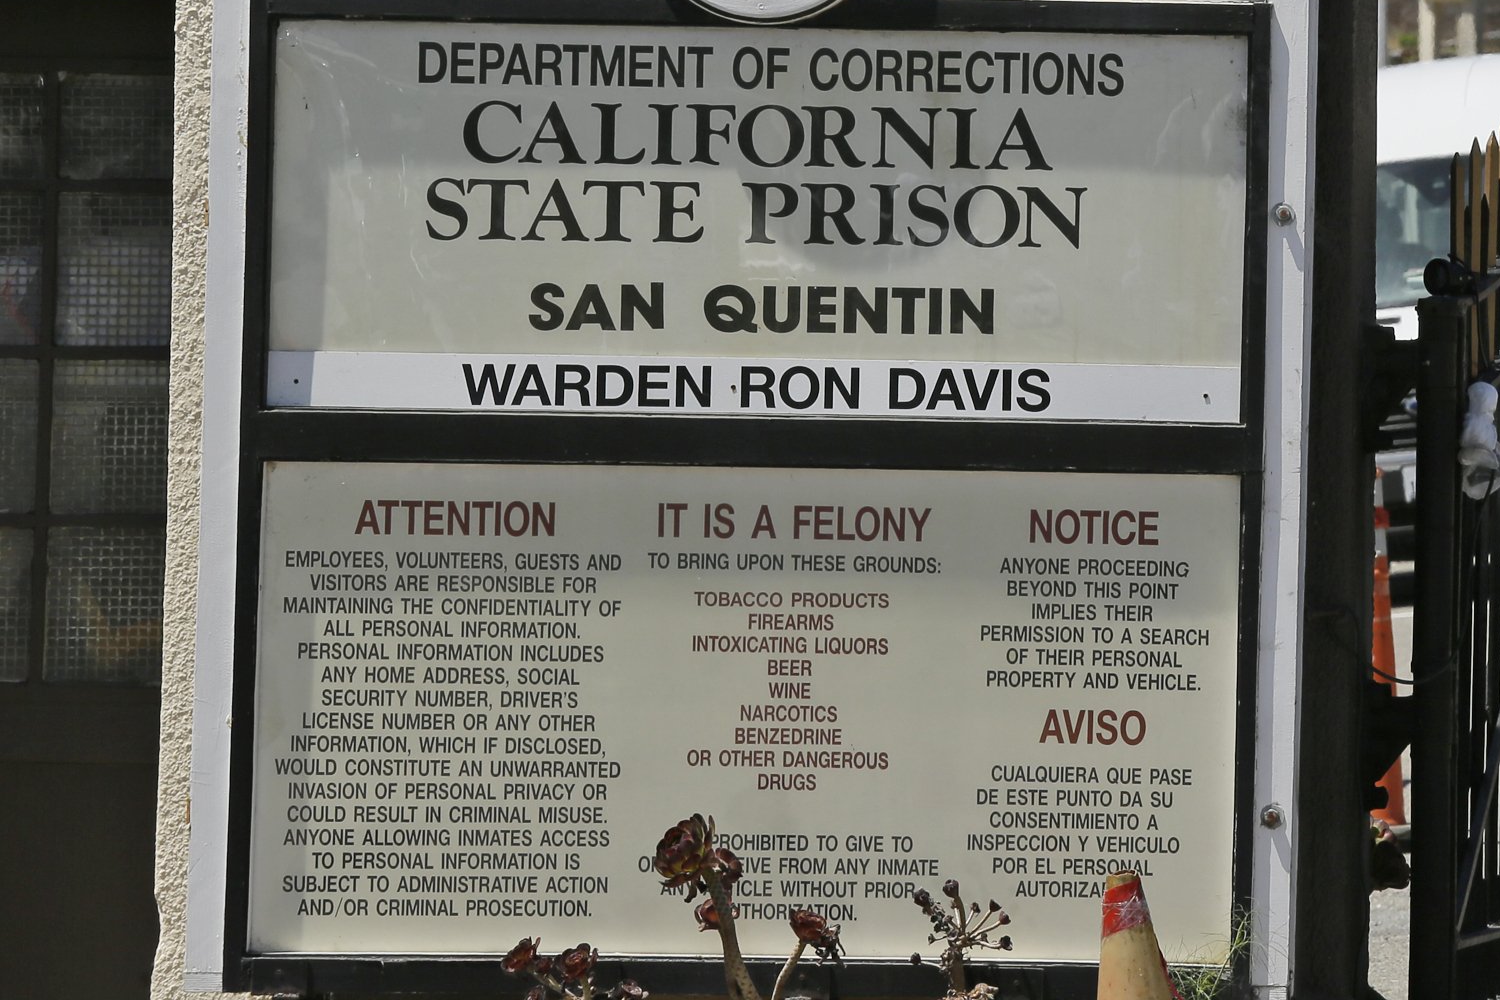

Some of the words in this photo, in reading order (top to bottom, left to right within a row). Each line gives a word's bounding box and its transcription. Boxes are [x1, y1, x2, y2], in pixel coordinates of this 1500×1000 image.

[419, 42, 713, 88] DEPARTMENT
[733, 47, 789, 89] OF
[810, 48, 1124, 96] CORRECTIONS
[463, 101, 1053, 170] CALIFORNIA
[426, 178, 704, 243] STATE
[742, 183, 1087, 249] PRISON
[529, 282, 664, 331] SAN
[704, 285, 994, 334] QUENTIN
[462, 364, 712, 407] WARDEN
[741, 366, 859, 410] RON
[889, 368, 1050, 412] DAVIS
[355, 500, 555, 536] ATTENTION
[658, 503, 687, 537] IT
[704, 504, 734, 538] IS
[751, 505, 776, 538] A
[794, 506, 931, 541] FELONY
[1030, 509, 1158, 545] NOTICE
[285, 550, 388, 572] EMPLOYEES,
[395, 551, 508, 573] VOLUNTEERS,
[514, 552, 580, 571] GUESTS
[586, 553, 622, 571] AND
[647, 552, 670, 570] TO
[677, 552, 730, 570] BRING
[736, 553, 784, 571] UPON
[790, 554, 846, 572] THESE
[853, 555, 942, 574] GROUNDS:
[999, 557, 1070, 576] ANYONE
[1077, 558, 1190, 578] PROCEEDING
[309, 573, 387, 592] VISITORS
[394, 574, 430, 592] ARE
[437, 574, 555, 594] RESPONSIBLE
[562, 576, 597, 594] FOR
[1006, 579, 1077, 598] BEYOND
[1083, 581, 1122, 599] THIS
[1128, 582, 1180, 600] POINT
[283, 596, 393, 615] MAINTAINING
[400, 597, 434, 615] THE
[441, 597, 592, 617] CONFIDENTIALITY
[598, 599, 622, 618] OF
[693, 591, 783, 608] TOBACCO
[791, 592, 890, 609] PRODUCTS
[748, 613, 834, 632] FIREARMS
[1031, 603, 1097, 621] IMPLIES
[1103, 604, 1153, 622] THEIR
[323, 619, 355, 637] ALL
[362, 619, 454, 638] PERSONAL
[460, 620, 581, 640] INFORMATION.
[980, 624, 1085, 643] PERMISSION
[1091, 626, 1114, 644] TO
[1120, 627, 1133, 645] A
[1139, 627, 1210, 647] SEARCH
[297, 642, 390, 660] PERSONAL
[396, 643, 513, 662] INFORMATION
[520, 644, 605, 663] INCLUDES
[692, 634, 807, 654] INTOXICATING
[814, 636, 889, 656] LIQUORS
[767, 659, 813, 677] BEER
[1006, 647, 1029, 665] OF
[1035, 648, 1085, 667] THEIR
[1091, 649, 1183, 668] PERSONAL
[320, 665, 358, 683] ANY
[364, 666, 416, 684] HOME
[422, 666, 510, 688] ADDRESS,
[517, 667, 581, 686] SOCIAL
[986, 669, 1077, 689] PROPERTY
[1082, 672, 1119, 690] AND
[1126, 672, 1202, 692] VEHICLE.
[321, 688, 408, 707] SECURITY
[414, 689, 493, 711] NUMBER,
[500, 690, 579, 709] DRIVER'S
[768, 681, 811, 700] WINE
[302, 711, 375, 730] LICENSE
[381, 712, 456, 731] NUMBER
[462, 713, 488, 731] OR
[494, 713, 532, 732] ANY
[538, 714, 596, 732] OTHER
[740, 704, 838, 723] NARCOTICS
[734, 727, 842, 746] BENZEDRINE
[1039, 709, 1146, 745] AVISO
[290, 734, 411, 757] INFORMATION,
[418, 736, 476, 754] WHICH
[483, 736, 499, 754] IF
[505, 736, 606, 759] DISCLOSED,
[274, 758, 337, 776] WOULD
[344, 758, 451, 777] CONSTITUTE
[458, 759, 483, 777] AN
[490, 760, 621, 779] UNWARRANTED
[686, 749, 712, 767] OR
[718, 749, 775, 768] OTHER
[782, 750, 889, 771] DANGEROUS
[757, 773, 817, 792] DRUGS
[991, 764, 1100, 784] CUALQUIERA
[1106, 766, 1142, 785] QUE
[1149, 768, 1193, 786] PASE
[288, 782, 367, 800] INVASION
[374, 782, 398, 800] OF
[404, 782, 497, 800] PERSONAL
[503, 783, 576, 801] PRIVACY
[582, 783, 607, 801] OR
[976, 788, 999, 806] DE
[1006, 788, 1049, 806] ESTE
[1056, 789, 1113, 808] PUNTO
[1119, 790, 1143, 808] DA
[1150, 790, 1173, 809] SU
[286, 804, 346, 823] COULD
[353, 805, 419, 823] RESULT
[425, 806, 442, 824] IN
[448, 805, 532, 824] CRIMINAL
[538, 806, 608, 824] MISUSE.
[989, 811, 1140, 831] CONSENTIMIENTO
[1146, 813, 1159, 831] A
[282, 828, 355, 846] ANYONE
[361, 828, 451, 847] ALLOWING
[458, 829, 533, 847] INMATES
[539, 829, 610, 848] ACCESS
[816, 834, 839, 852] TO
[845, 835, 884, 853] GIVE
[890, 836, 914, 853] TO
[967, 833, 1070, 853] INSPECCION
[1077, 835, 1089, 853] Y
[1095, 835, 1180, 855] VEHICULO
[311, 851, 335, 870] TO
[342, 851, 434, 870] PERSONAL
[441, 852, 557, 870] INFORMATION
[564, 852, 581, 871] IS
[778, 857, 828, 875] FROM
[834, 858, 872, 875] ANY
[877, 859, 940, 876] INMATE
[992, 857, 1028, 875] POR
[1035, 858, 1056, 875] EL
[1063, 858, 1154, 877] PERSONAL
[282, 874, 361, 893] SUBJECT
[366, 875, 390, 893] TO
[396, 875, 538, 894] ADMINISTRATIVE
[545, 875, 609, 894] ACTION
[780, 880, 858, 898] WITHOUT
[864, 881, 915, 899] PRIOR
[1015, 880, 1106, 899] AUTORIZA
[296, 897, 369, 918] AND/OR
[376, 898, 459, 917] CRIMINAL
[465, 898, 592, 918] PROSECUTION.
